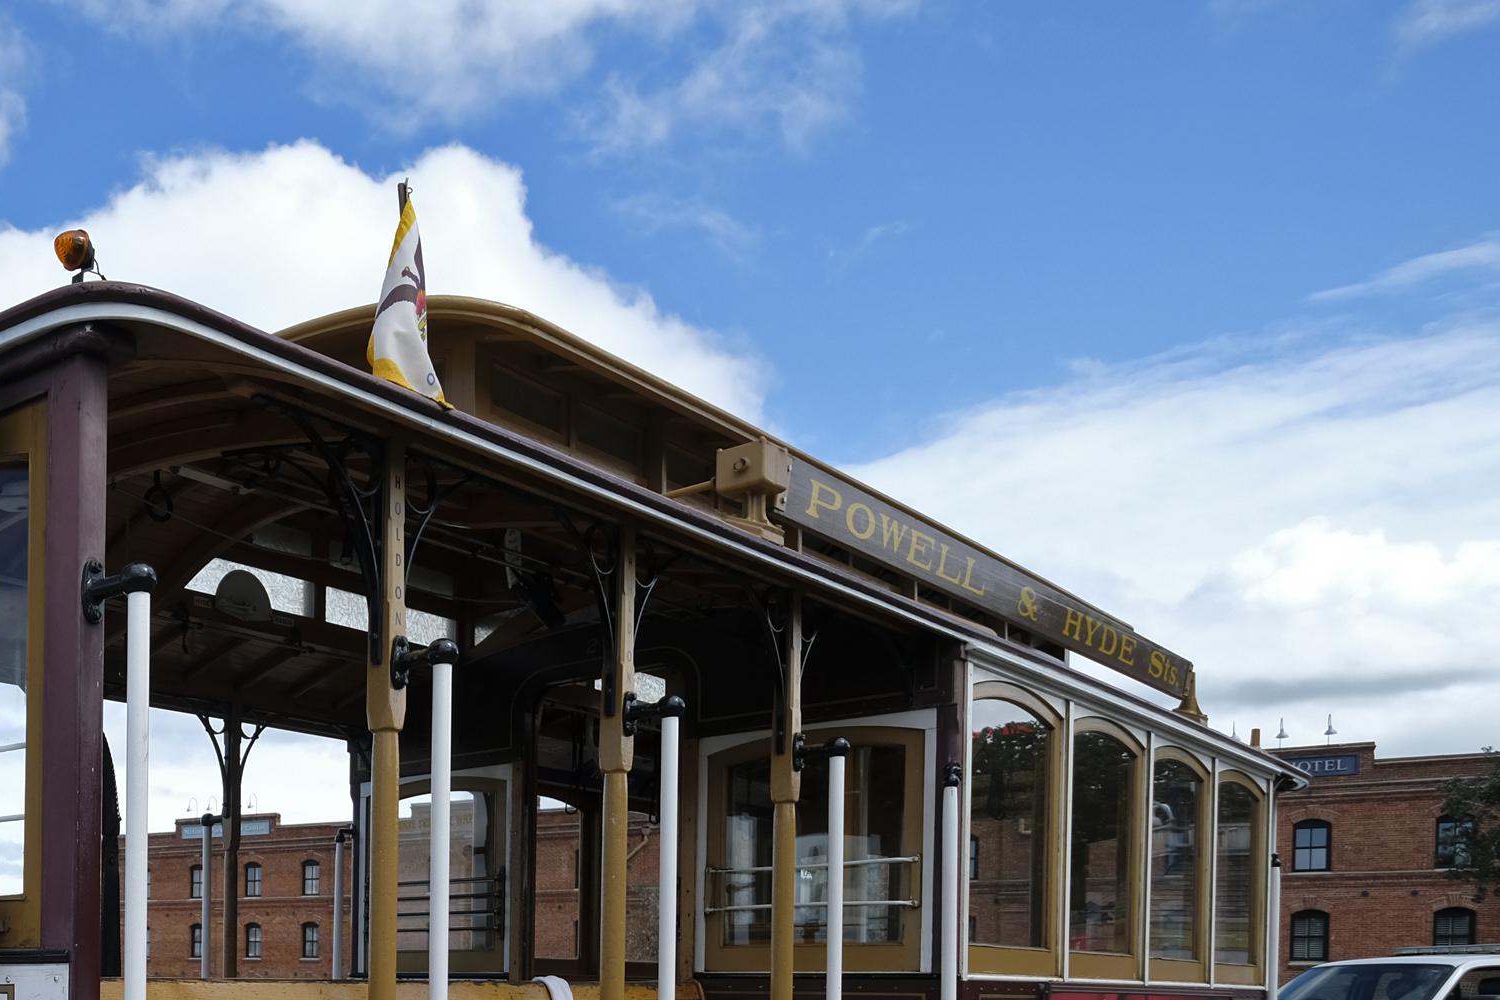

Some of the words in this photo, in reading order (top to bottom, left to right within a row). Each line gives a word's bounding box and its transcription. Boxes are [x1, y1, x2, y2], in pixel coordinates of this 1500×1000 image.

[394, 475, 402, 567] HOLD
[394, 585, 402, 626] ON
[805, 479, 985, 596] POWELL
[1018, 586, 1037, 621] &
[1062, 608, 1139, 666] HYDE
[1149, 650, 1179, 688] Sts.
[1293, 759, 1348, 774] OTEL
